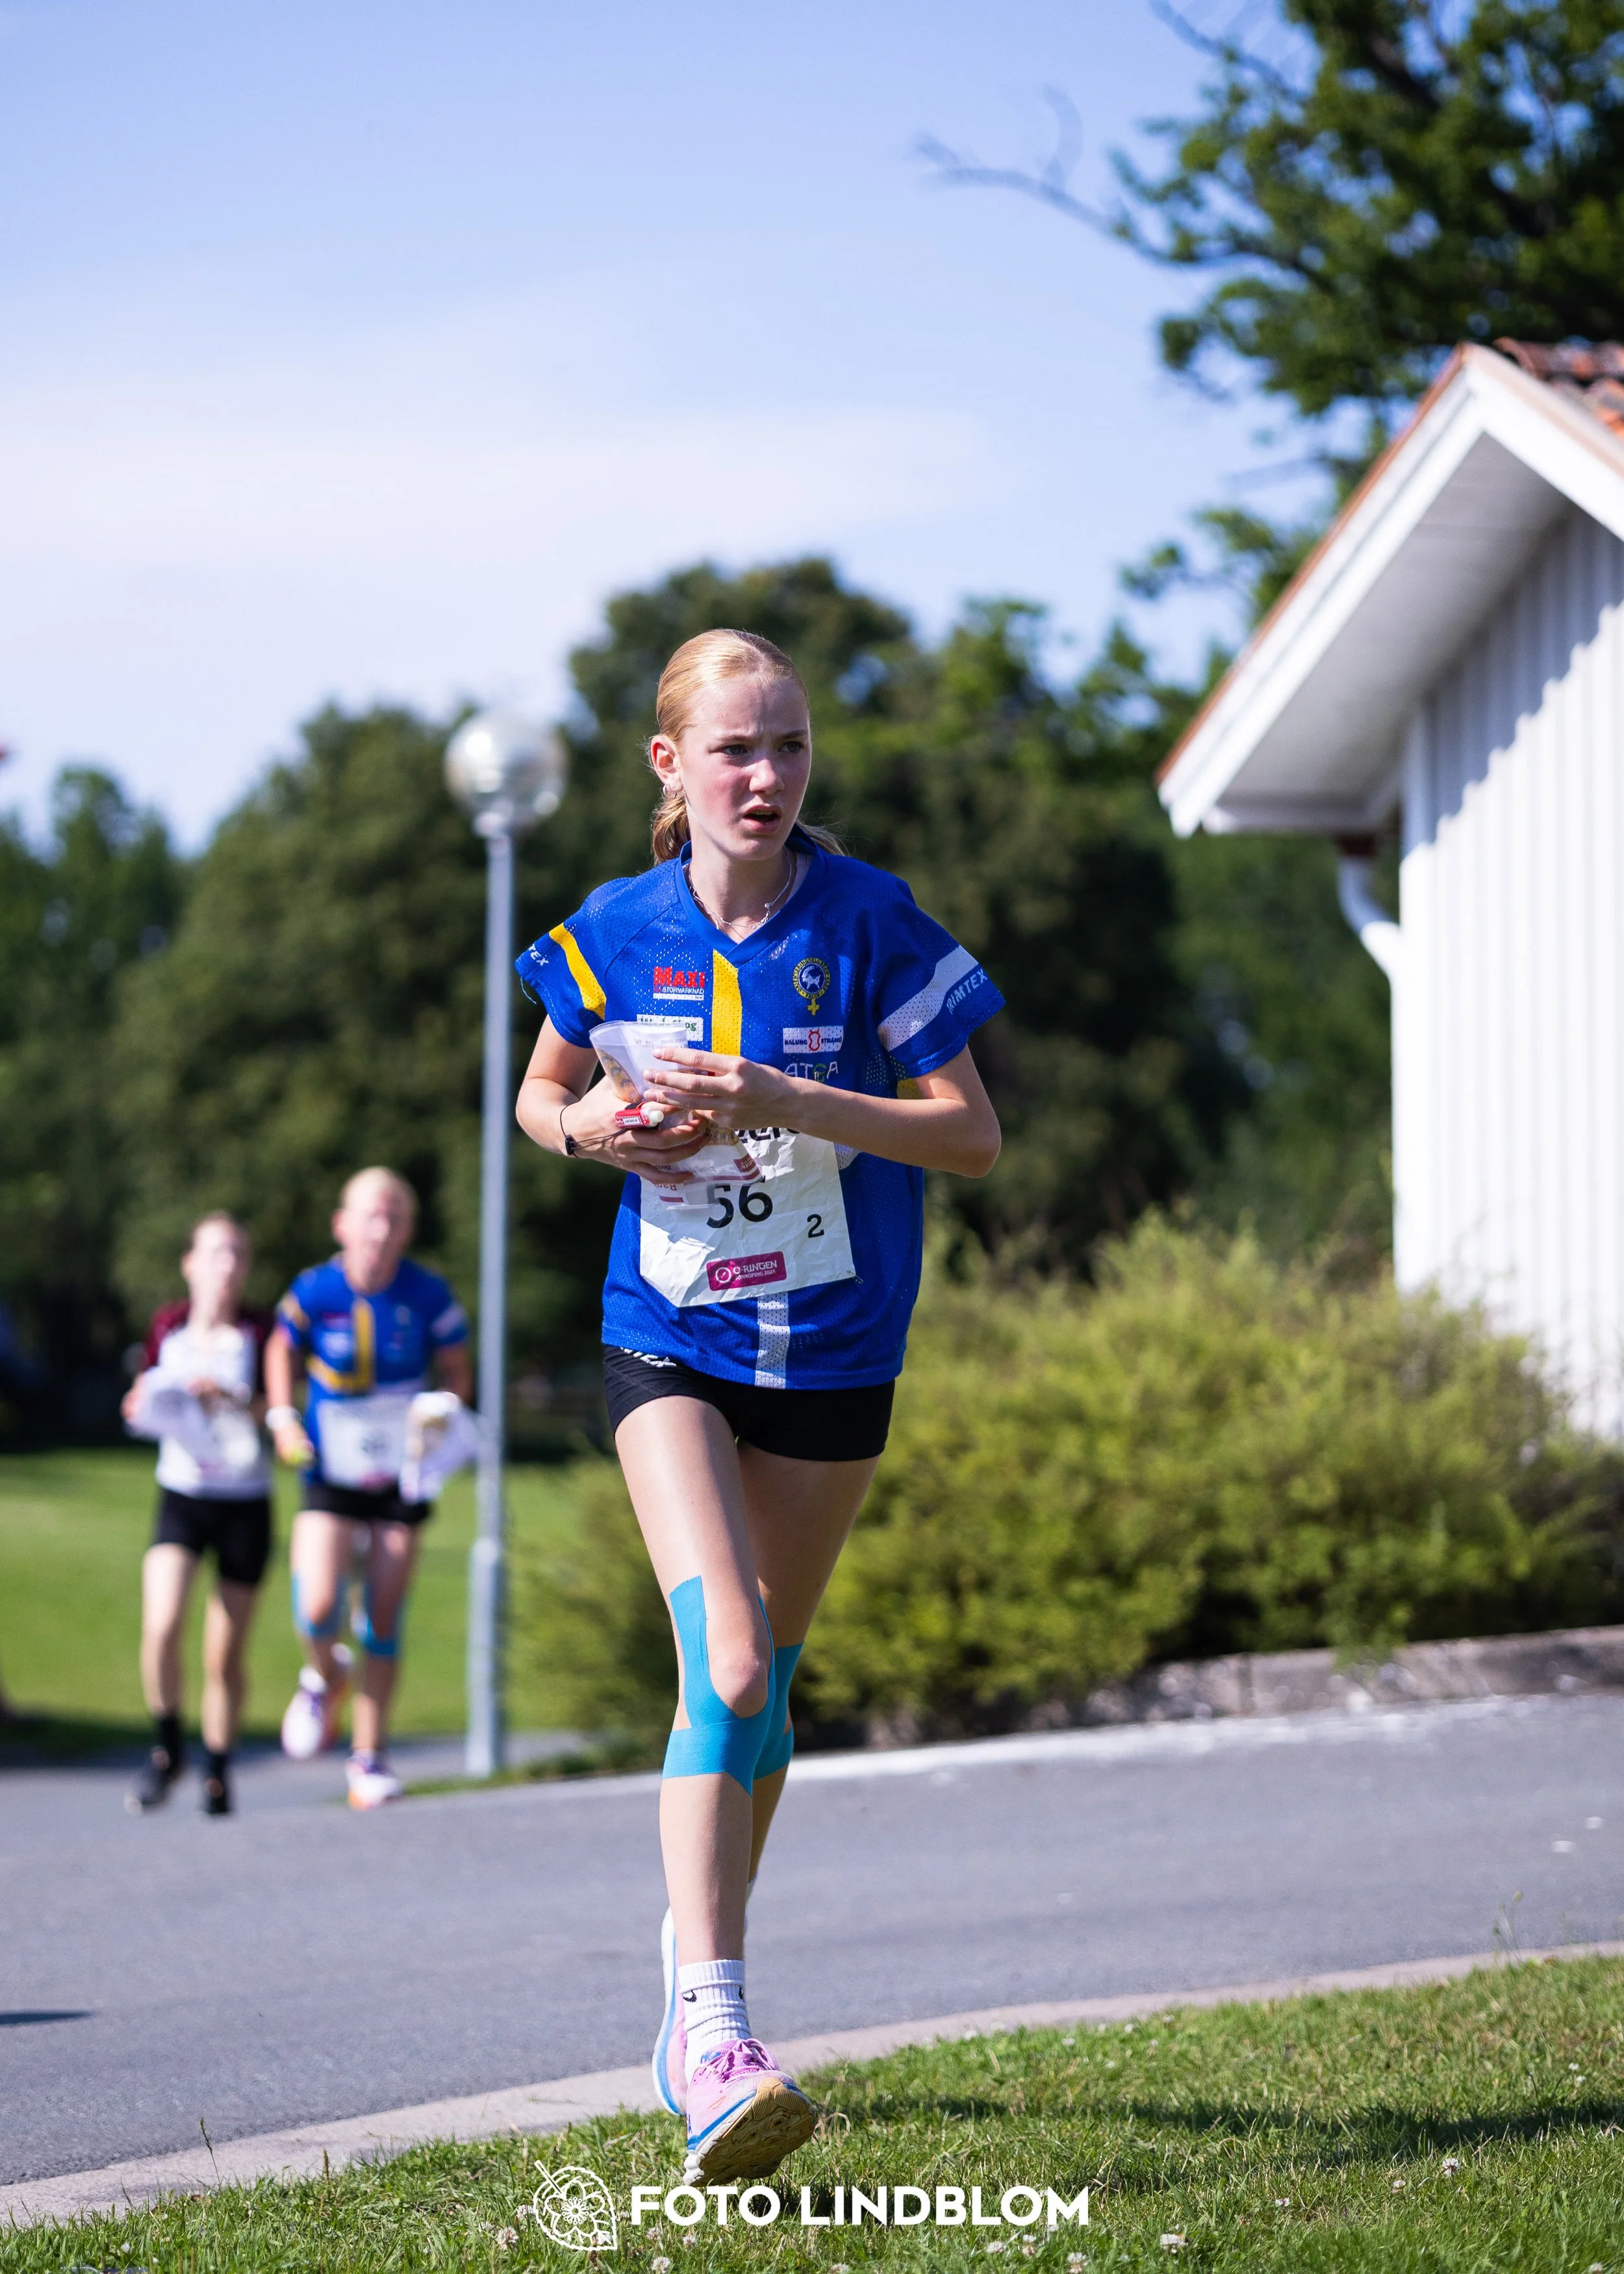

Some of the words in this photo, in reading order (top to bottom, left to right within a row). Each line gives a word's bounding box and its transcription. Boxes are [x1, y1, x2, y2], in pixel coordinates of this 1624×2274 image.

[653, 966, 705, 988] MAXI
[662, 986, 704, 995] STORMARKNAD
[946, 969, 987, 1015] TRIMTEX
[706, 1176, 774, 1229] 56
[806, 1213, 825, 1238] 2
[733, 1260, 778, 1275] O-RINGEN
